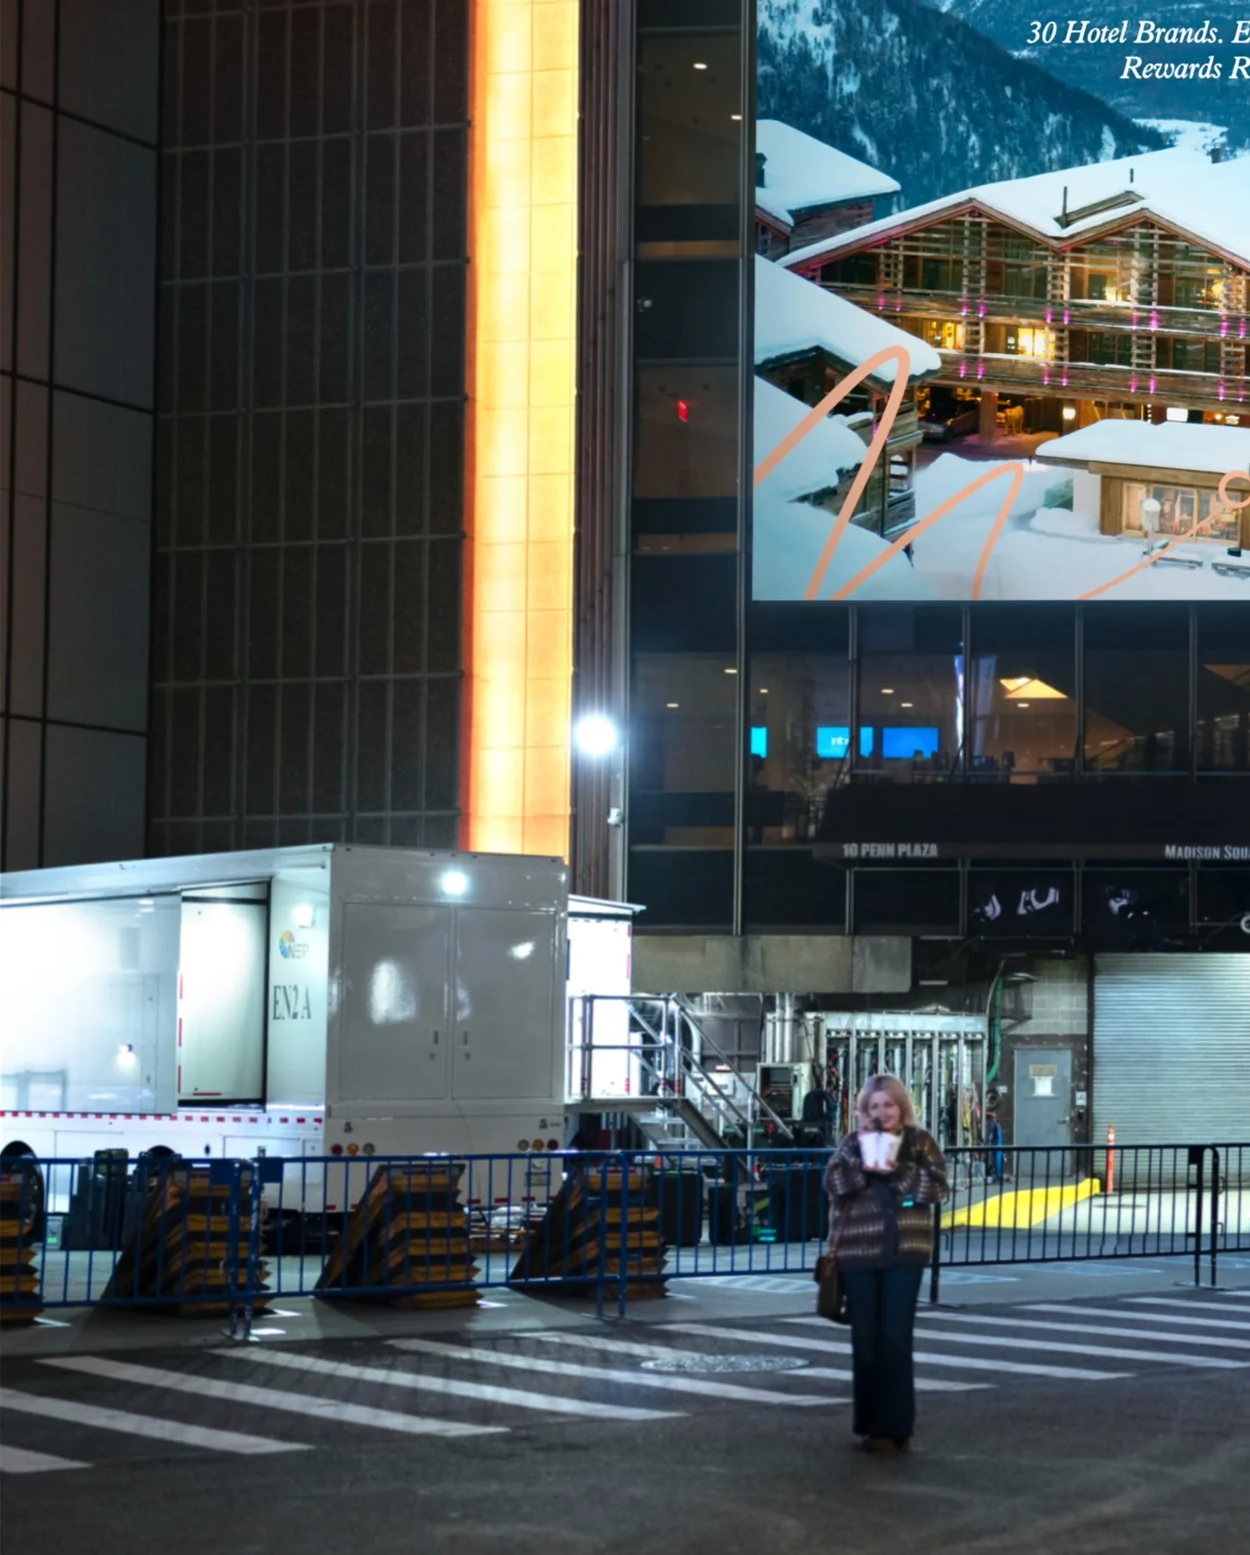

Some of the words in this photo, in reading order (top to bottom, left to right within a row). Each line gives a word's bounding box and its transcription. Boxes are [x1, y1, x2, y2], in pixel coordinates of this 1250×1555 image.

[1026, 21, 1057, 44] 30
[1062, 20, 1129, 44] Hotel
[1133, 20, 1223, 44] Brands.
[1119, 55, 1223, 79] Rewards
[842, 843, 859, 857] 10
[860, 843, 895, 857] PENN
[897, 843, 938, 857] PLAZA
[1164, 845, 1220, 859] MADISON
